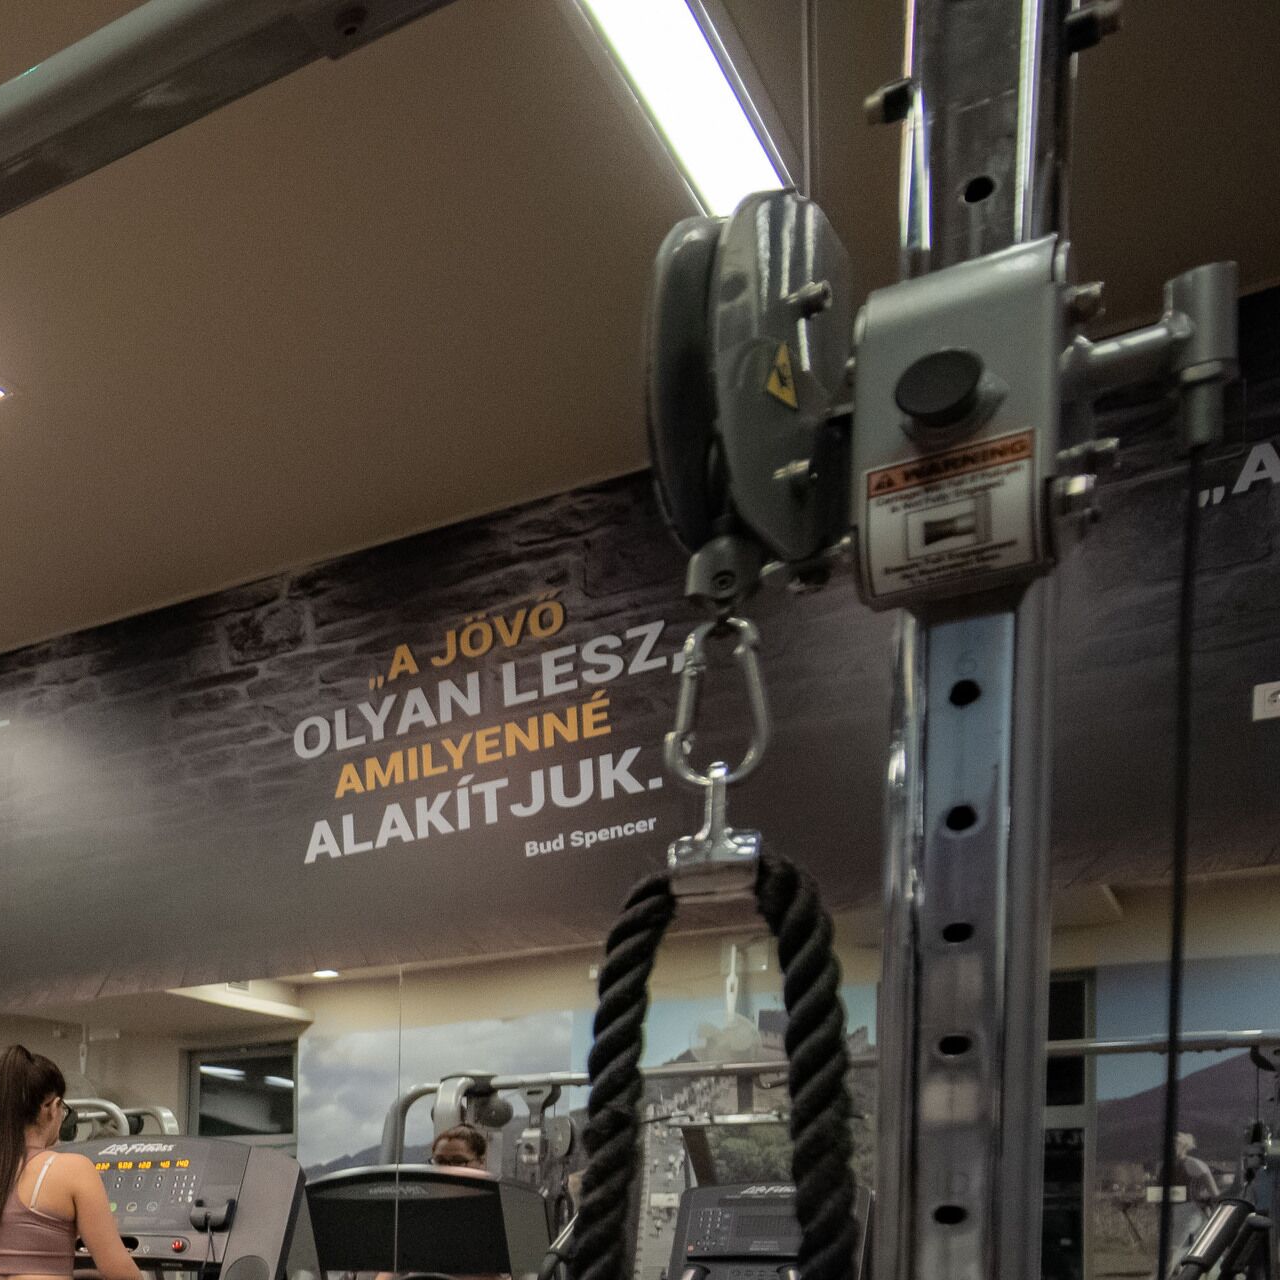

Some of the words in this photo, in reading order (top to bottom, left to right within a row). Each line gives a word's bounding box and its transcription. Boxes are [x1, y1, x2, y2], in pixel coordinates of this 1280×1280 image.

[431, 587, 567, 668] JÖVŐ
[293, 670, 481, 759] OLYAN
[334, 690, 612, 799] AMILYENNÉ
[303, 746, 664, 865] ALAKÍTJUK.
[524, 833, 564, 857] Bud
[569, 815, 657, 849] Spencer
